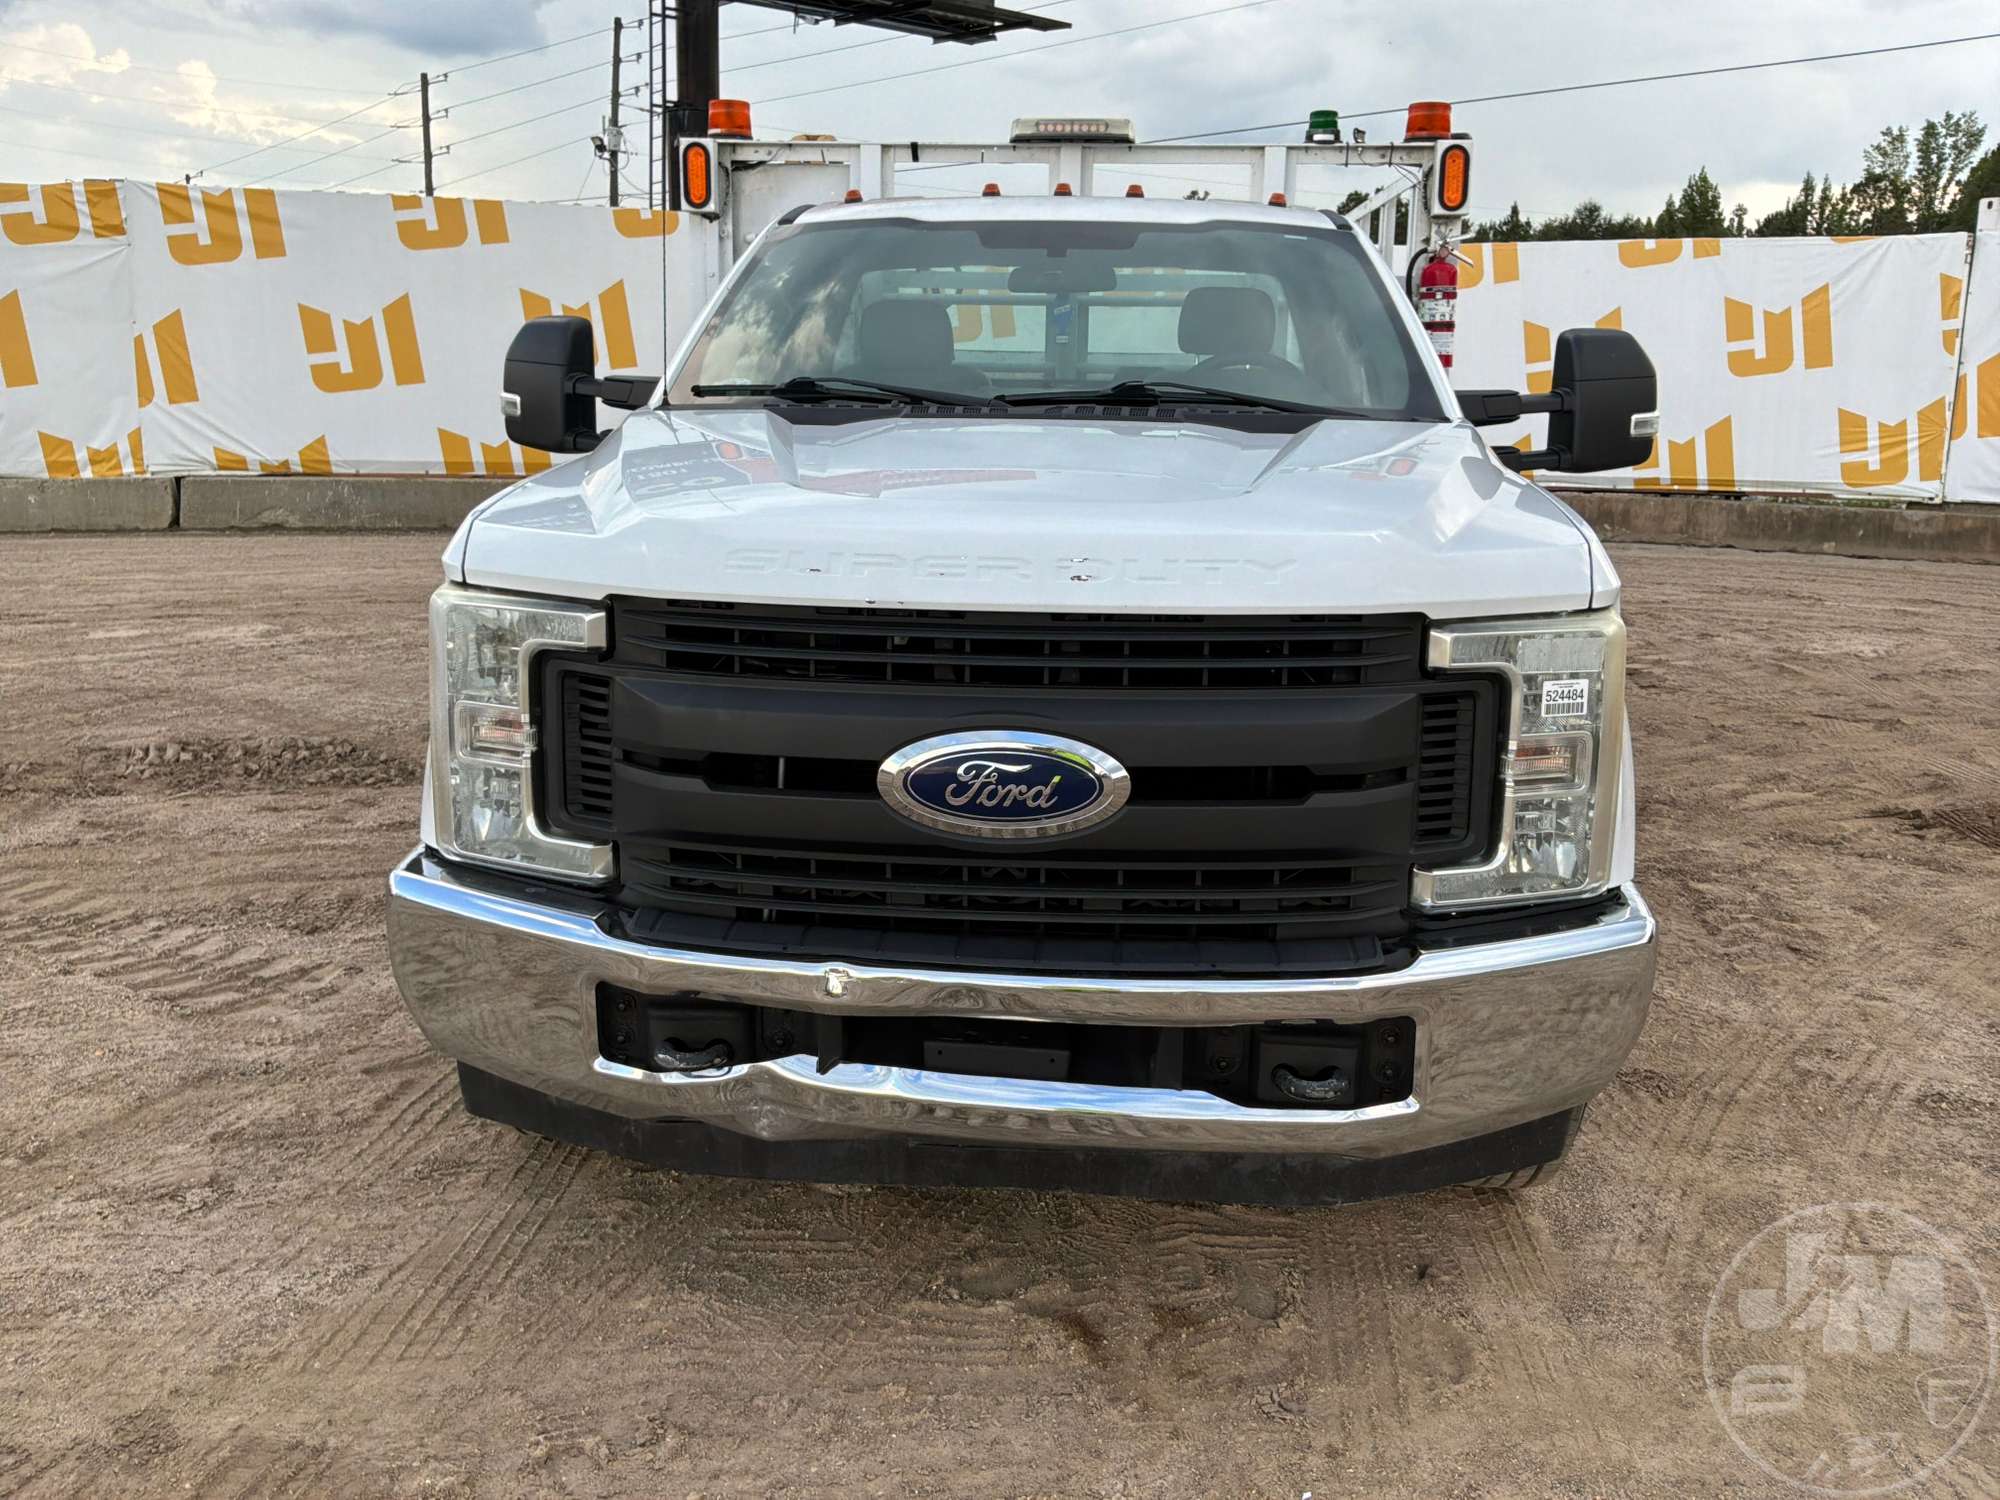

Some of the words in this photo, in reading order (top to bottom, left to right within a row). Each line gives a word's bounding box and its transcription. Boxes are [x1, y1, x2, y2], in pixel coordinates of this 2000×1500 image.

[723, 547, 1034, 583] SUPER
[1054, 555, 1298, 586] DUTY
[1545, 687, 1584, 703] 524484
[944, 760, 1063, 808] Ford
